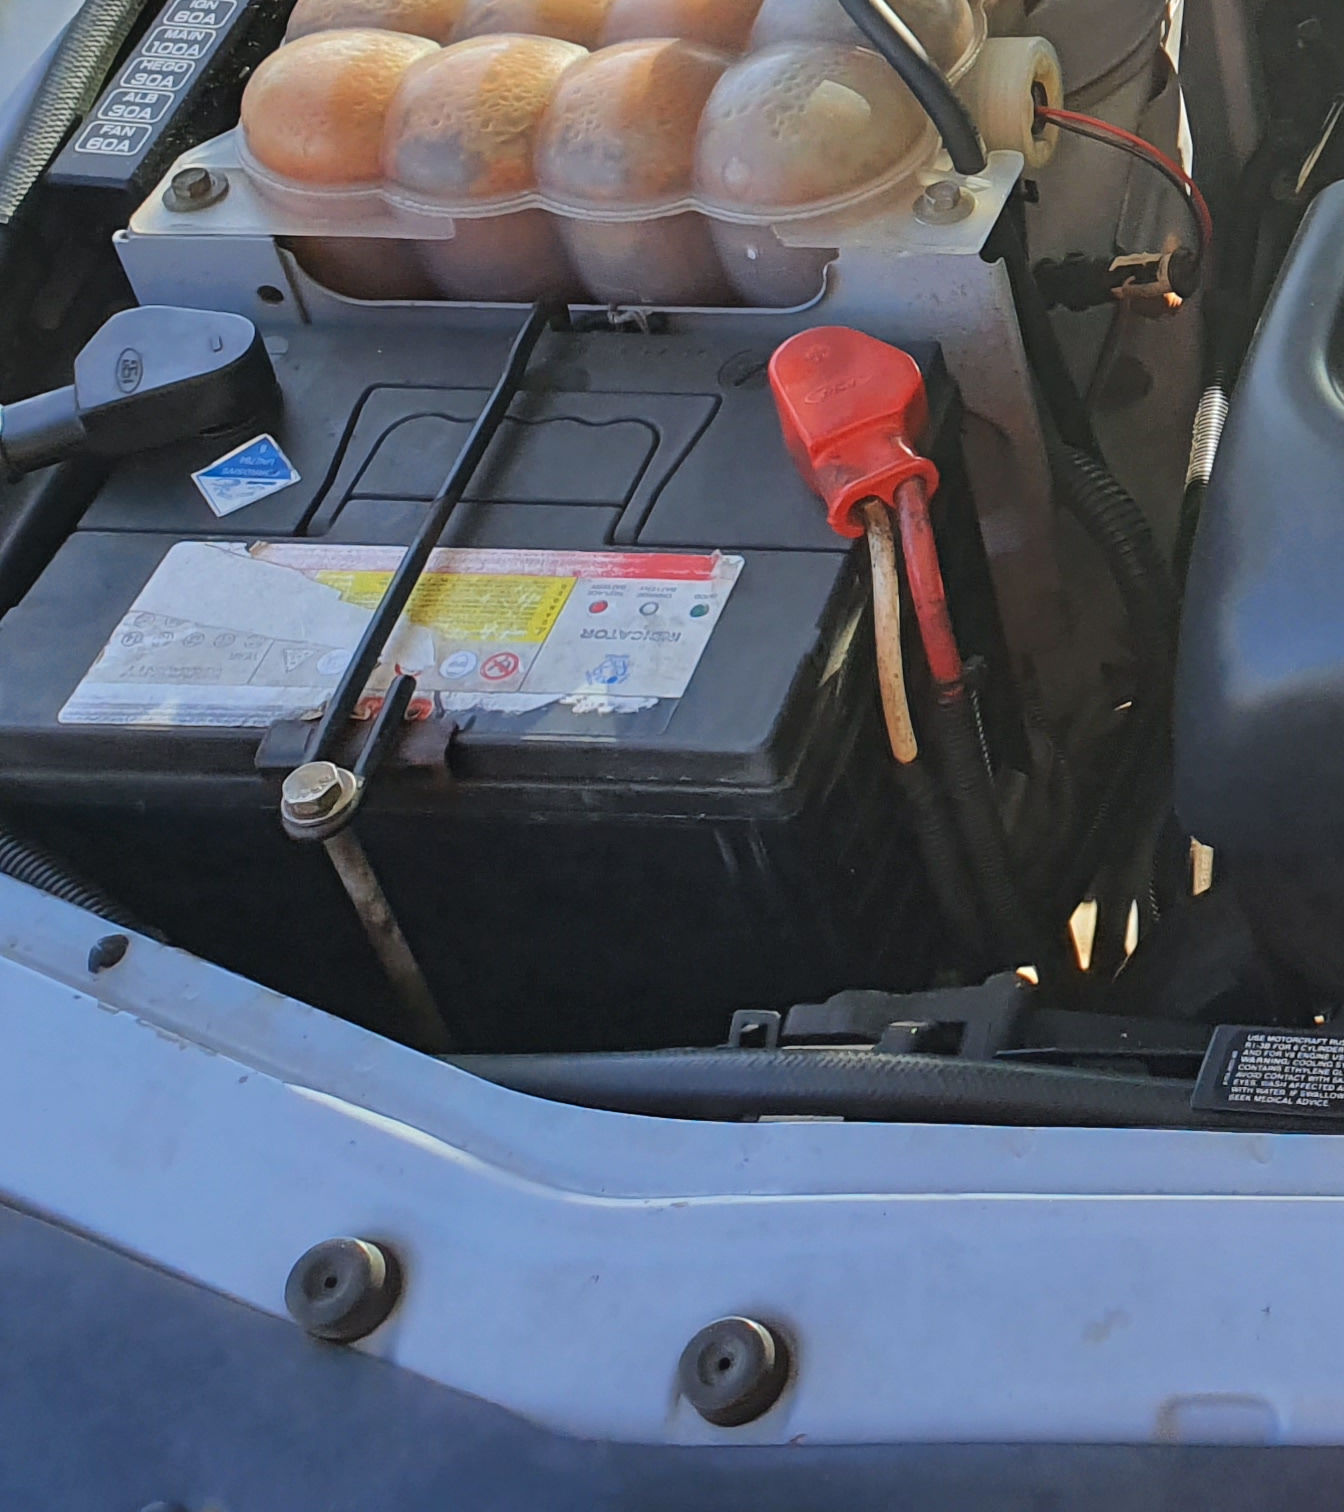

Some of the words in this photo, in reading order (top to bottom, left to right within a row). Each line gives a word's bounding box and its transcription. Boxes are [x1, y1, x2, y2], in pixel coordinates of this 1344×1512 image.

[190, 0, 219, 10] IGN
[163, 30, 205, 42] MAIN
[151, 41, 200, 56] 100A
[139, 60, 188, 73] HEGO
[130, 73, 174, 88] 30A
[108, 104, 153, 119] 30A
[99, 124, 136, 138] FAN
[580, 628, 682, 642] INDICATOR
[1247, 1034, 1266, 1042] USE
[1267, 1035, 1328, 1045] MOTORCRAFT
[1300, 1045, 1344, 1053] CYLINDER
[1297, 1052, 1330, 1060] ENGINE
[1292, 1059, 1333, 1068] COOLING
[1238, 1064, 1282, 1072] CONTAINS
[1284, 1066, 1330, 1075] ETHYLENE
[1235, 1071, 1262, 1079] AVOID
[1264, 1073, 1306, 1081] CONTACT
[1308, 1075, 1330, 1083] WITH
[1231, 1086, 1254, 1094] WITH
[1288, 1082, 1335, 1091] AFFECTED
[1228, 1094, 1251, 1102] SEEK
[1254, 1095, 1293, 1105] MEDICAL
